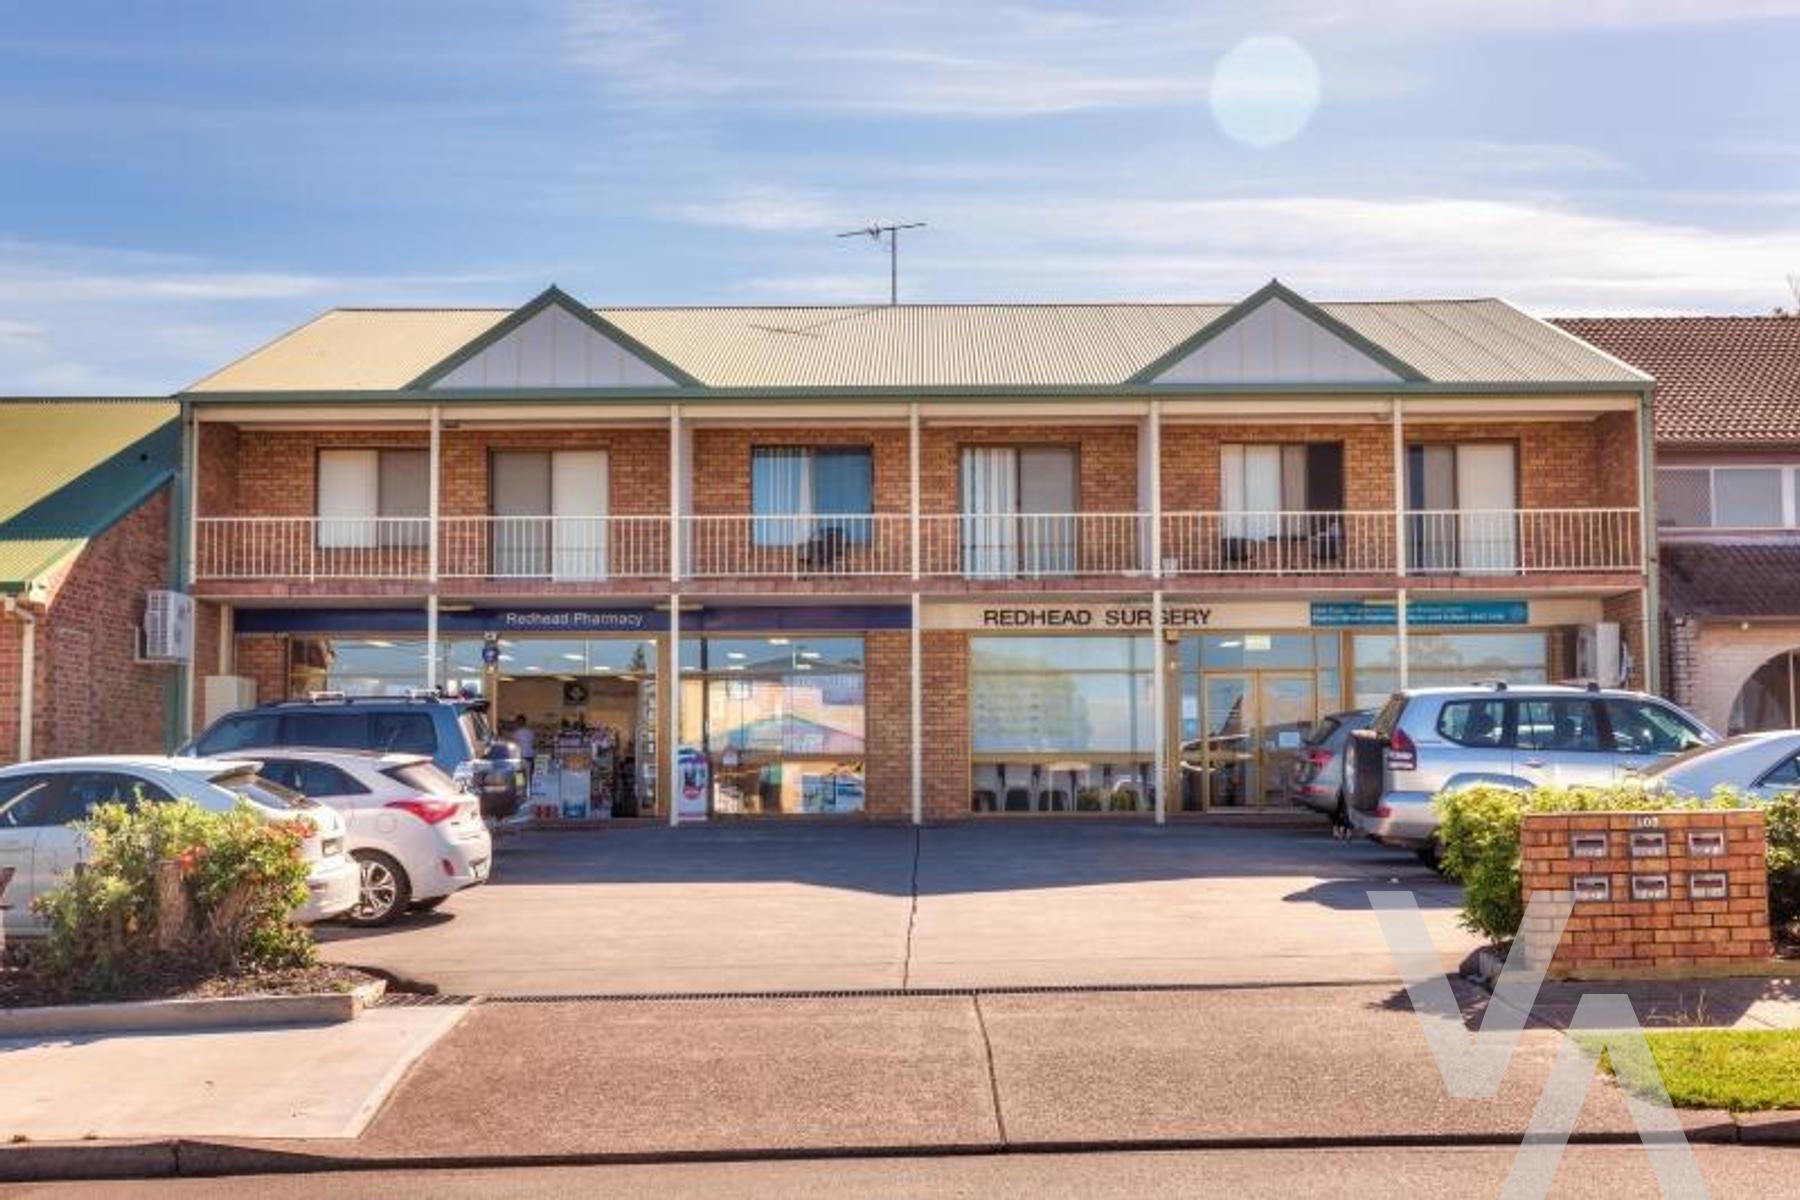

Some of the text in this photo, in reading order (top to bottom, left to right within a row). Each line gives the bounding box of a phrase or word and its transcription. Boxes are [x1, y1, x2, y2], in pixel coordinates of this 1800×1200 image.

[506, 612, 643, 627] Redhead Pharmacy
[983, 609, 1092, 625] REDHEAD
